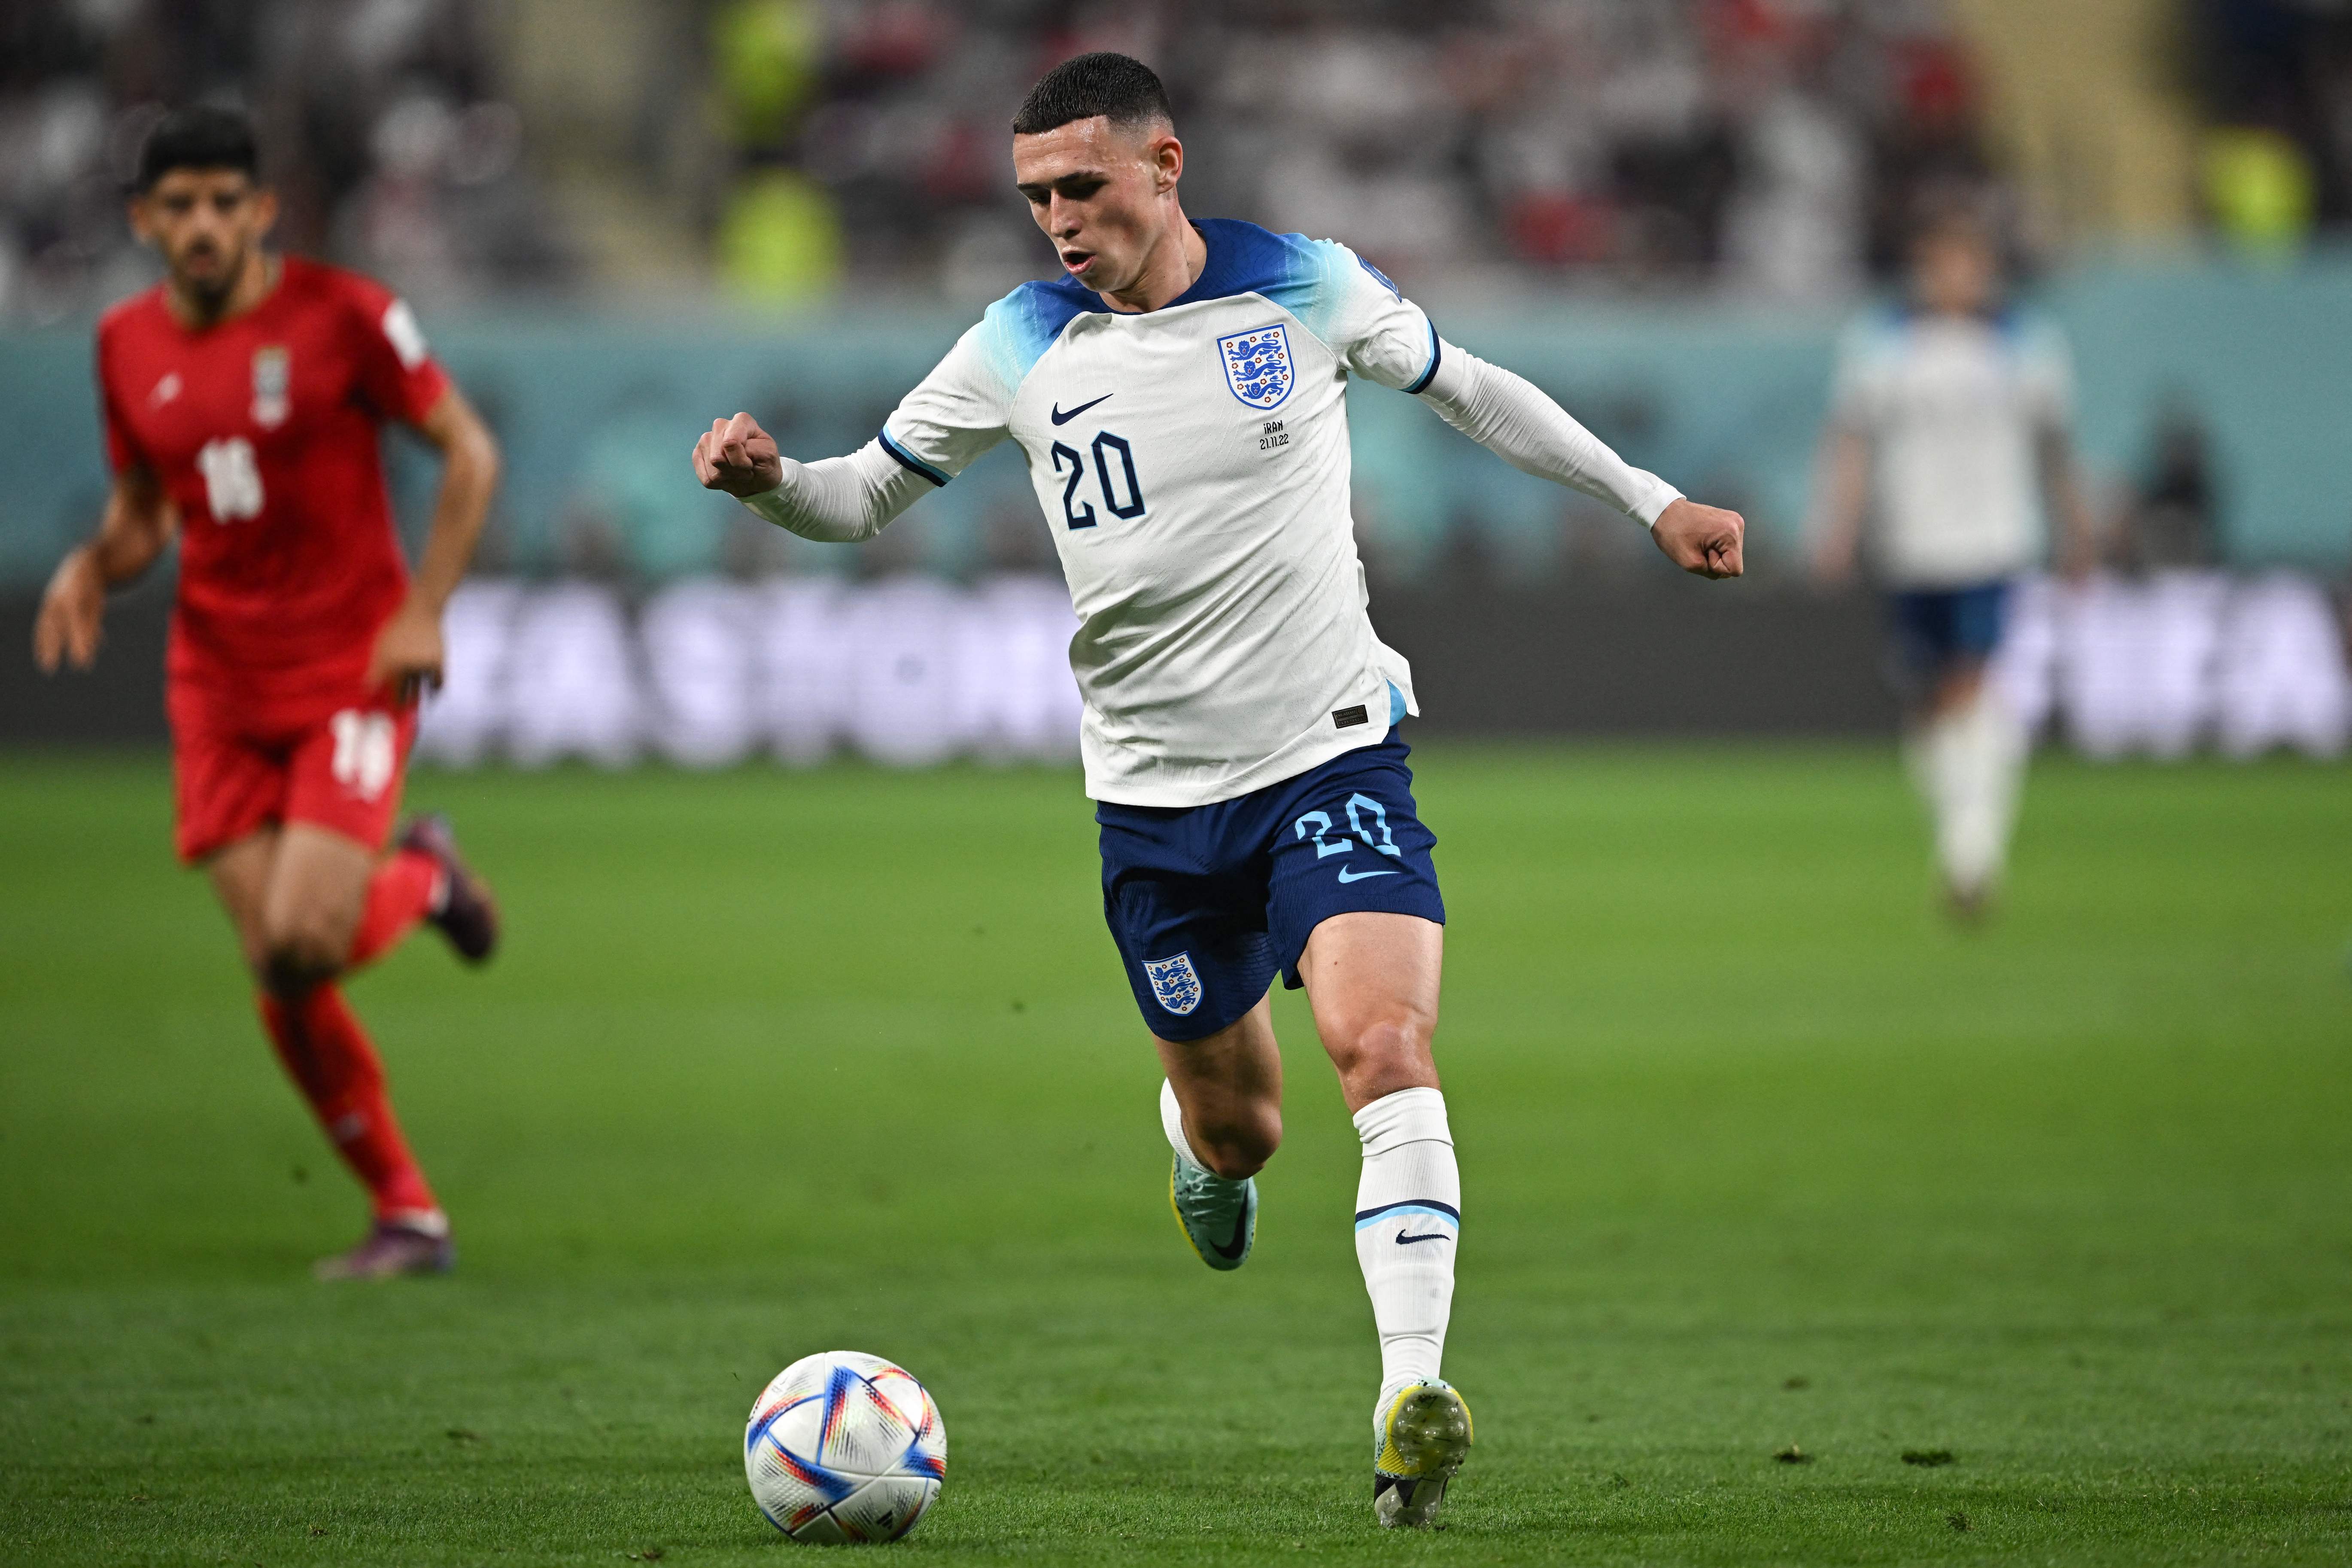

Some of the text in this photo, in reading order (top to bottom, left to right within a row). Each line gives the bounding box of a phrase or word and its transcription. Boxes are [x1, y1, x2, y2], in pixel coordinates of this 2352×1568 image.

[1260, 433, 1288, 450] 21.11.22
[1051, 429, 1146, 531] 20
[1295, 792, 1401, 860] 20
